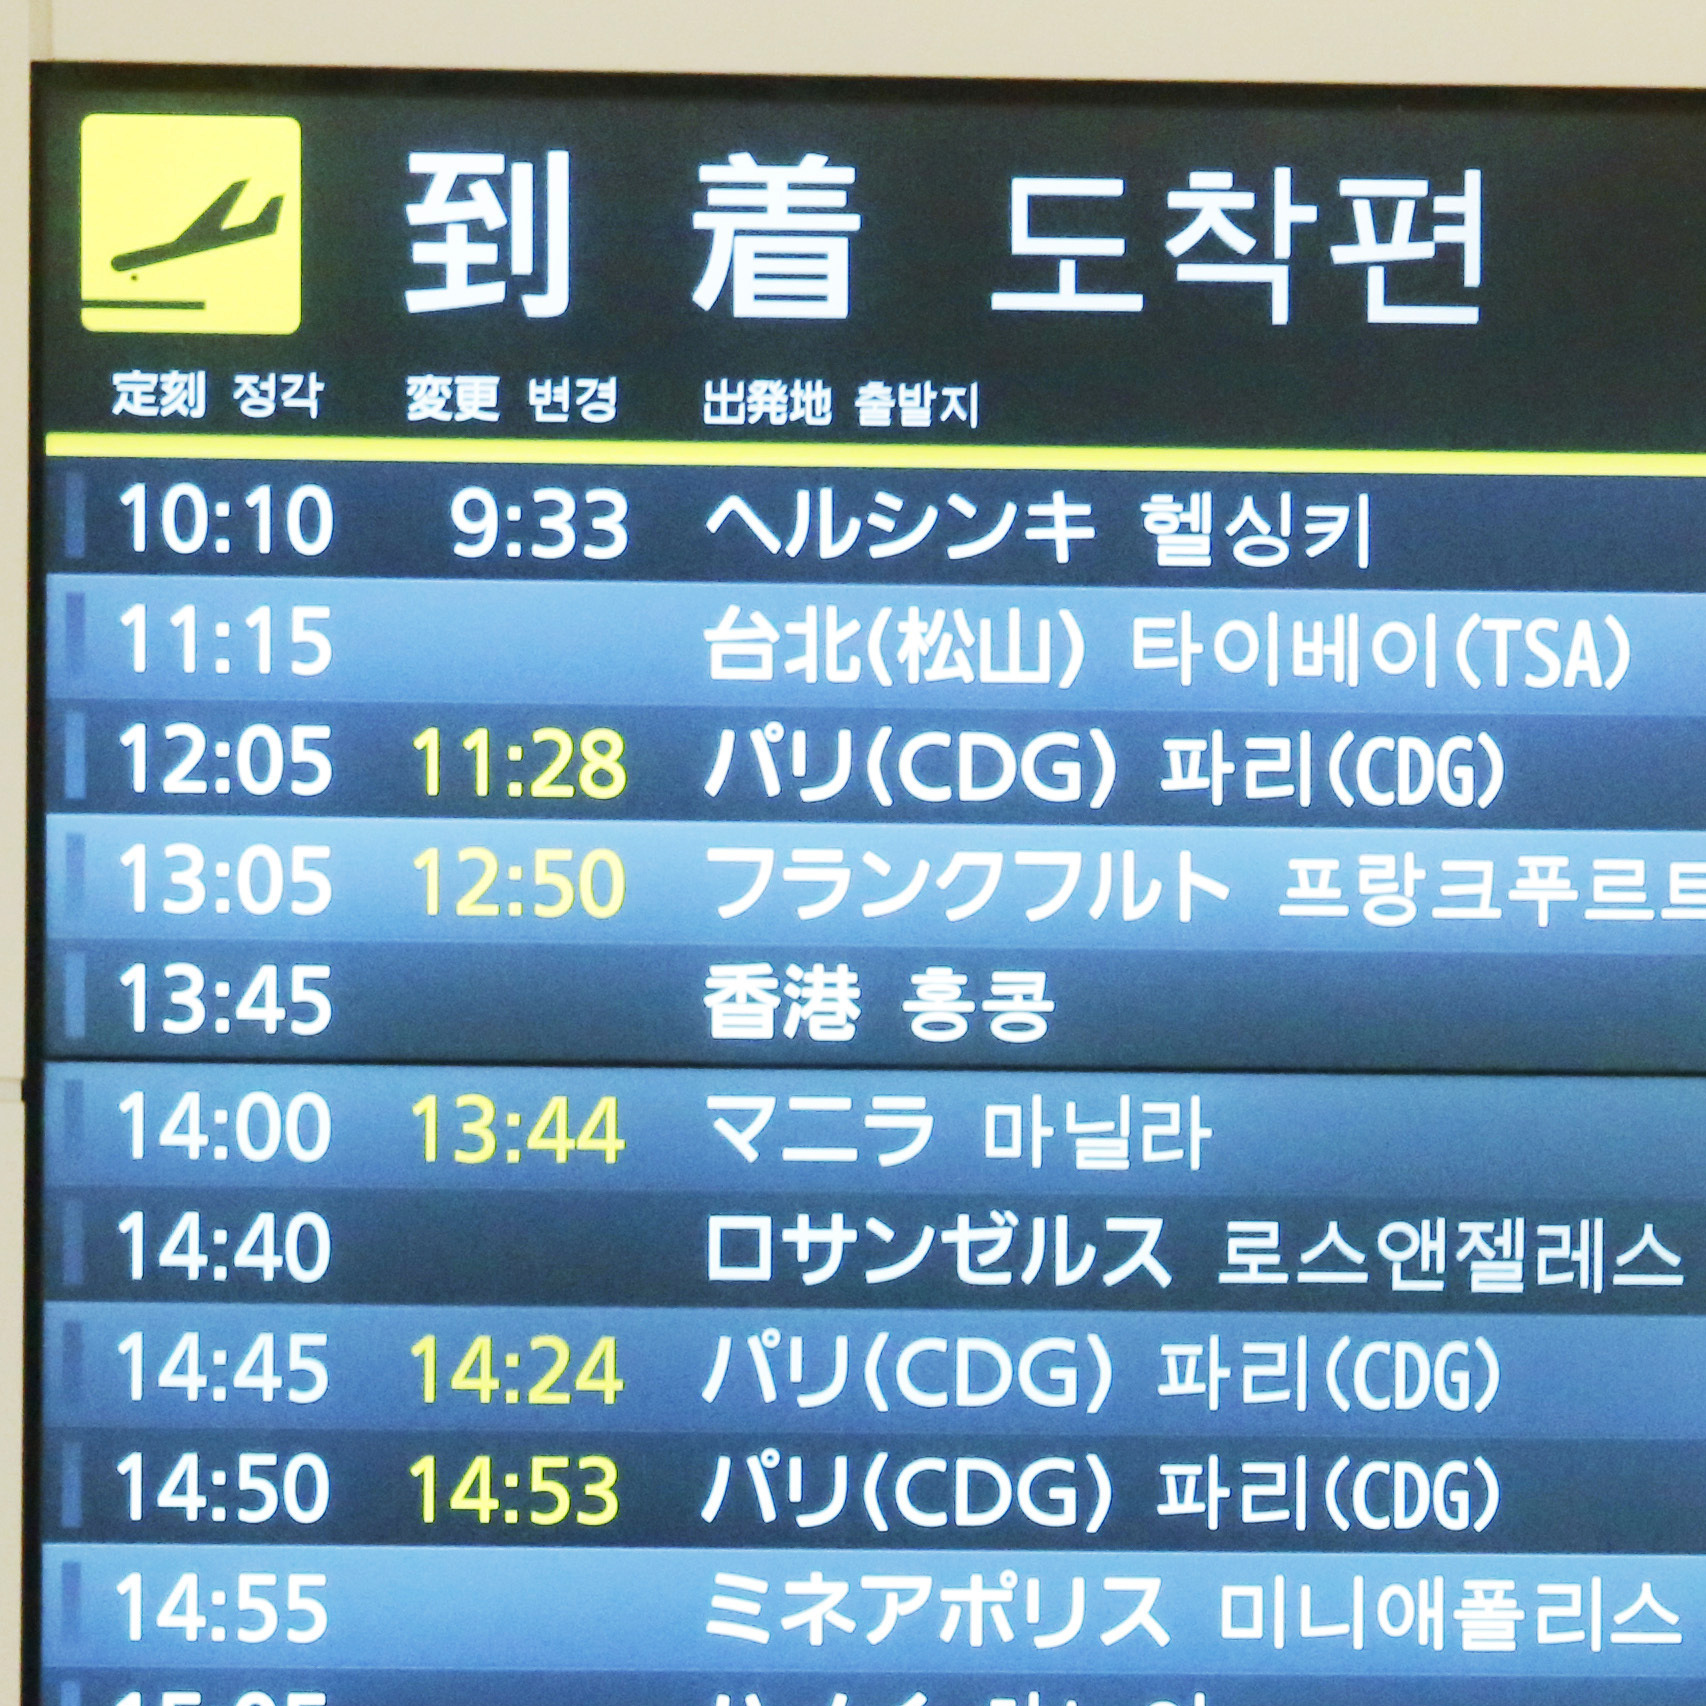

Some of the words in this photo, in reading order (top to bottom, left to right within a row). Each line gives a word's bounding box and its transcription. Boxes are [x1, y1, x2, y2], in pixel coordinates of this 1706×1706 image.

[406, 151, 569, 317] 到
[693, 153, 860, 318] 着
[992, 167, 1481, 325] 도착편
[113, 370, 205, 418] 定刻
[234, 372, 324, 419] 정각
[407, 375, 499, 421] 変更
[529, 377, 616, 422] 변경
[704, 379, 832, 425] 出発地
[855, 381, 977, 429] 출발지
[121, 483, 333, 556] 10:10
[451, 487, 627, 559] 9:33
[706, 488, 1095, 563] ヘルシンキ
[1141, 492, 1372, 568] 헬싱키
[120, 603, 332, 676] 11:15
[703, 604, 1085, 689] 台北(松山)
[1133, 610, 1630, 691] 타이베이(TSA)
[120, 723, 332, 796] 12:05
[413, 727, 626, 799] 11:28
[705, 721, 1116, 808] パリ(CDG)
[1160, 729, 1504, 809] 파리(CDG)
[120, 842, 332, 916] 13:05
[413, 846, 625, 919] 12:50
[706, 847, 1230, 922] フランクフルト
[120, 963, 331, 1035] 13:45
[703, 963, 861, 1041] 香港
[903, 967, 1054, 1043] 홍콩
[119, 1091, 331, 1162] 14:00
[412, 1094, 625, 1164] 13:44
[707, 1096, 933, 1167] マニラ
[985, 1094, 1212, 1170] 마닐라
[119, 1211, 330, 1282] 14:40
[709, 1210, 1171, 1287] ロサンゼルス
[1219, 1217, 1683, 1293] 로스앤젤레스
[118, 1332, 328, 1403] 14:45
[411, 1335, 624, 1404] 14:24
[702, 1328, 1112, 1413] パリ(CDG)
[1158, 1335, 1499, 1413] 파리(CDG)
[117, 1453, 329, 1523] 14:50
[410, 1456, 618, 1526] 14:53
[701, 1448, 1111, 1533] パリ(CDG)
[1157, 1455, 1499, 1532] 파리(CDG)
[116, 1572, 327, 1644] 14:55
[706, 1569, 1170, 1649] ミネアポリス
[1221, 1575, 1682, 1652] 미니애폴리스
